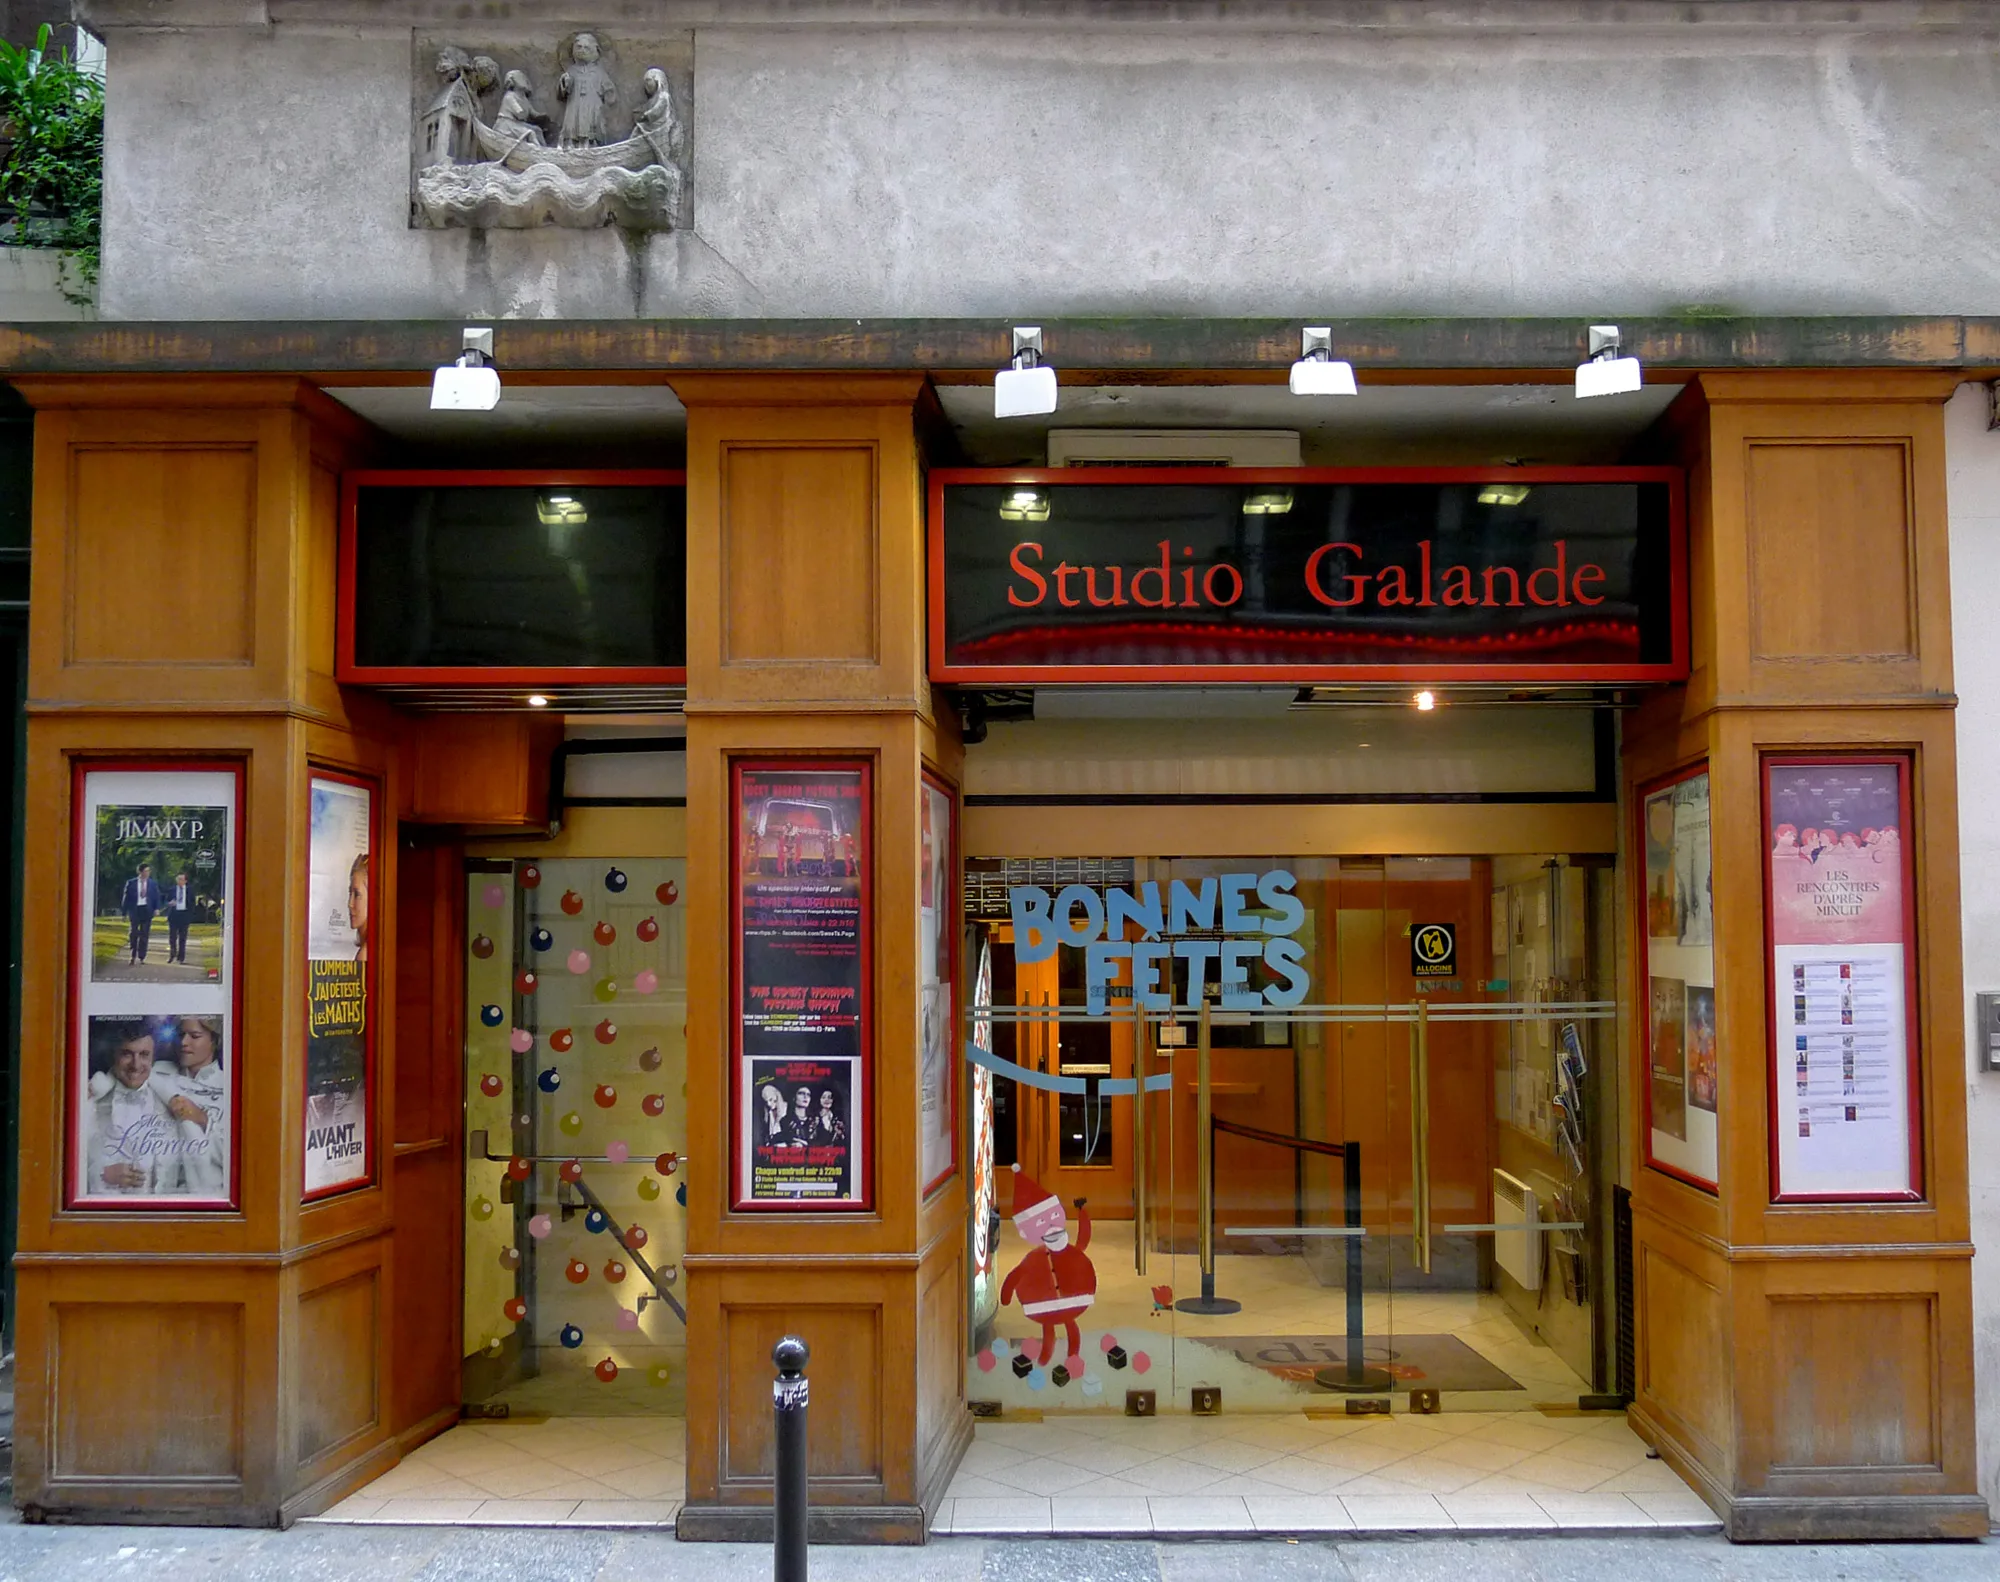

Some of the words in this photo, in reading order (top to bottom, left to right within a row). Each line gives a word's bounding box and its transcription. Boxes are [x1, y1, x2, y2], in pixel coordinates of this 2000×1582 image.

[1007, 540, 1243, 608] Studio
[1304, 540, 1606, 608] Galande
[115, 819, 187, 841] JIMMY
[190, 820, 205, 840] P.
[1826, 871, 1849, 881] LES
[1796, 882, 1880, 893] RENCONTRES
[1813, 893, 1863, 905] D'APRÈS
[1009, 869, 1306, 964] BONNES
[1816, 905, 1862, 916] MINUIT
[315, 960, 357, 976] COMMENT
[1416, 965, 1453, 973] ALLOCINE
[314, 1012, 326, 1025] LES
[325, 1001, 360, 1024] MATHS
[103, 1119, 209, 1161] Liberace
[307, 1123, 355, 1151] AVANT
[326, 1142, 362, 1160] L'HIVER
[778, 1166, 805, 1176] vendredi
